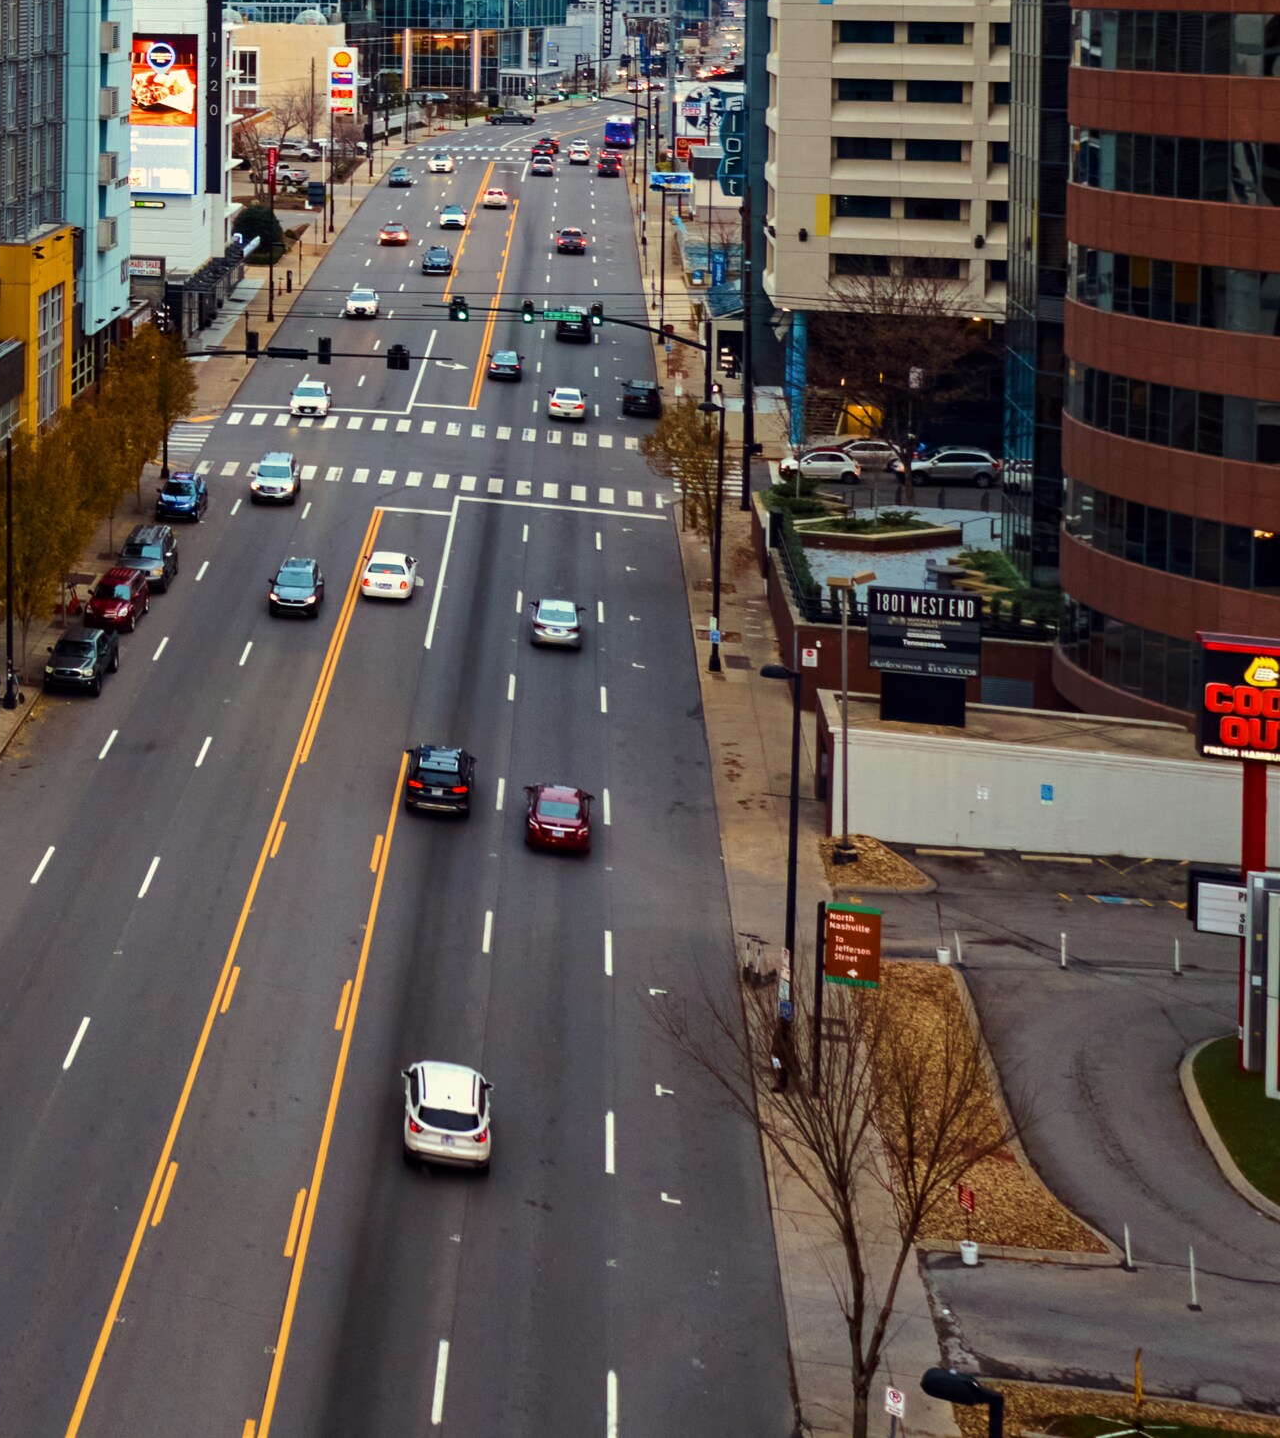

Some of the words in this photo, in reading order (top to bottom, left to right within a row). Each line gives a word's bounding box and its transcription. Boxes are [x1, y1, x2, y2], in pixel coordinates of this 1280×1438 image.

[209, 32, 219, 116] 1720
[724, 92, 744, 195] aloft
[876, 592, 905, 613] 1801
[911, 595, 945, 616] WEST
[949, 598, 975, 619] END
[1219, 715, 1280, 750] OU
[1203, 745, 1239, 758] FRESH
[1240, 749, 1280, 762] HAMBU
[829, 912, 855, 922] North
[829, 921, 871, 934] Nashville
[835, 935, 844, 943] To
[834, 944, 872, 956] Jefferson
[834, 952, 858, 963] Street
